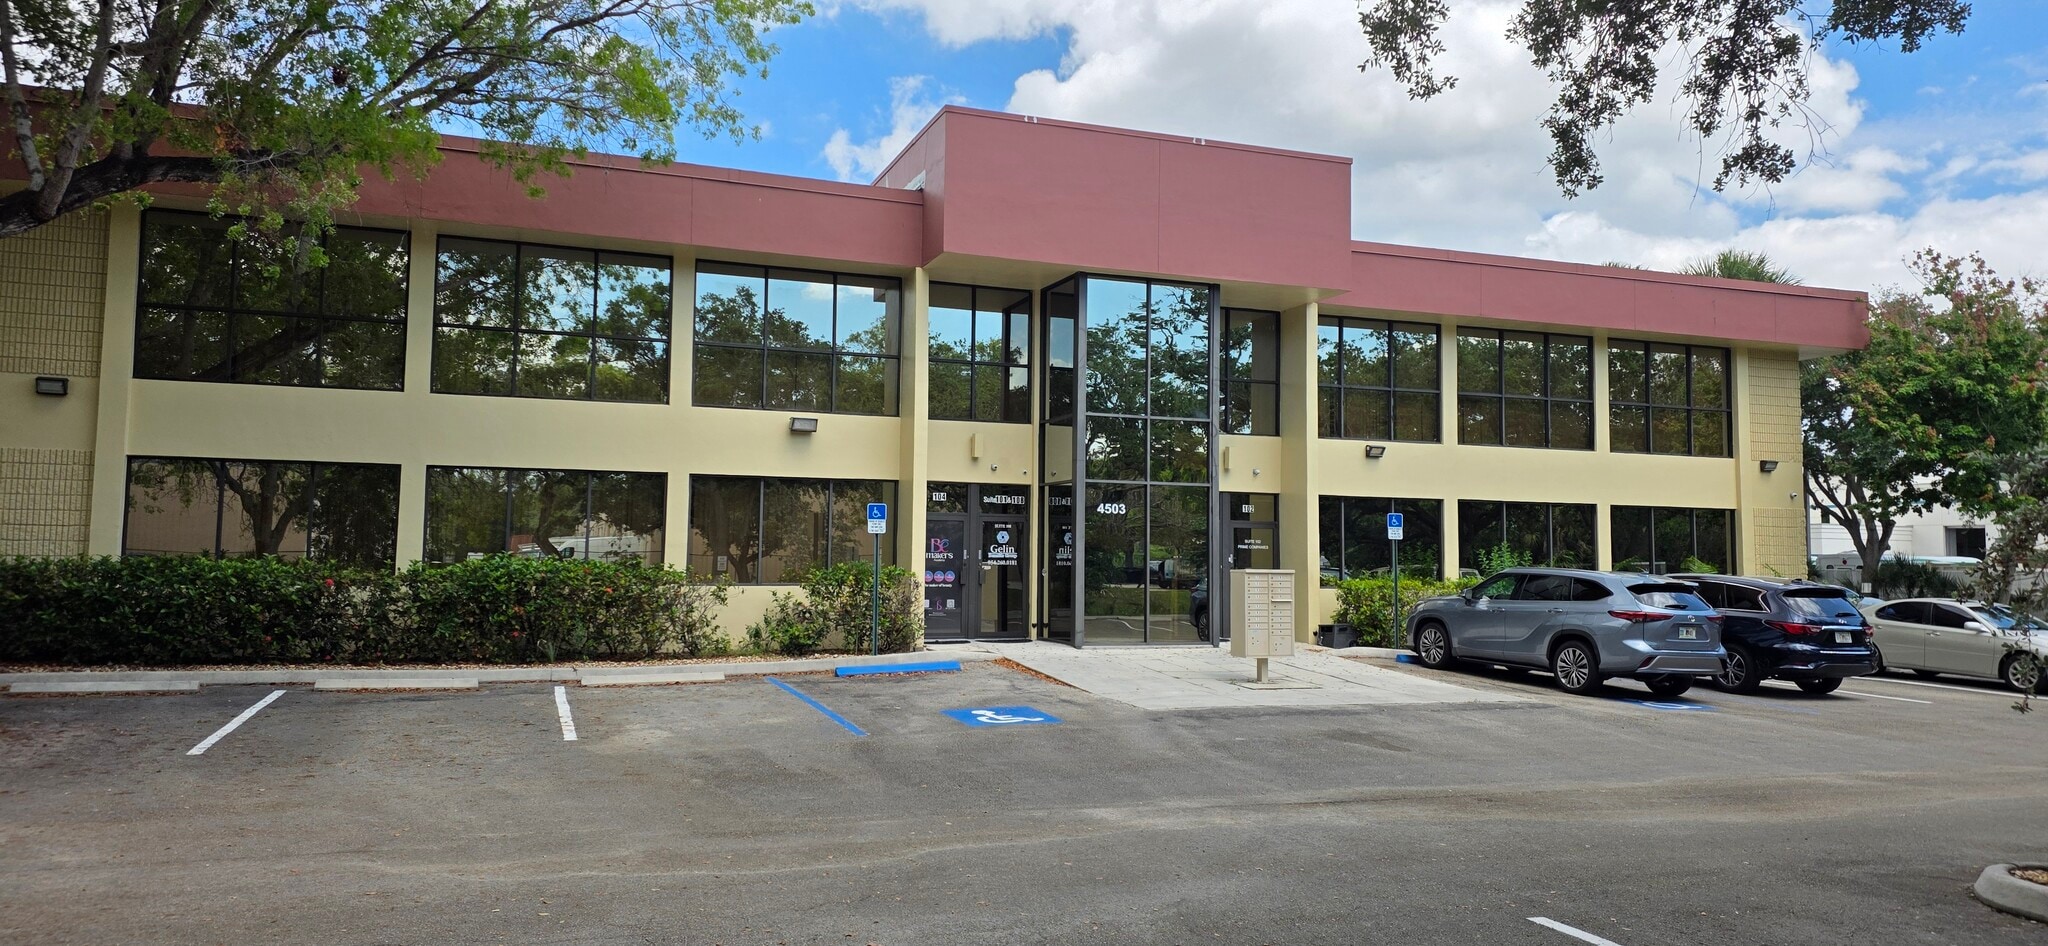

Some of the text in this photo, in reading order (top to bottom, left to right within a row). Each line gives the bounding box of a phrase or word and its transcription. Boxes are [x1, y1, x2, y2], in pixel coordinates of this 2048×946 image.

[933, 492, 946, 501] 104
[1097, 503, 1126, 514] 4503
[1242, 504, 1254, 513] 102
[990, 544, 1015, 554] Gelin
